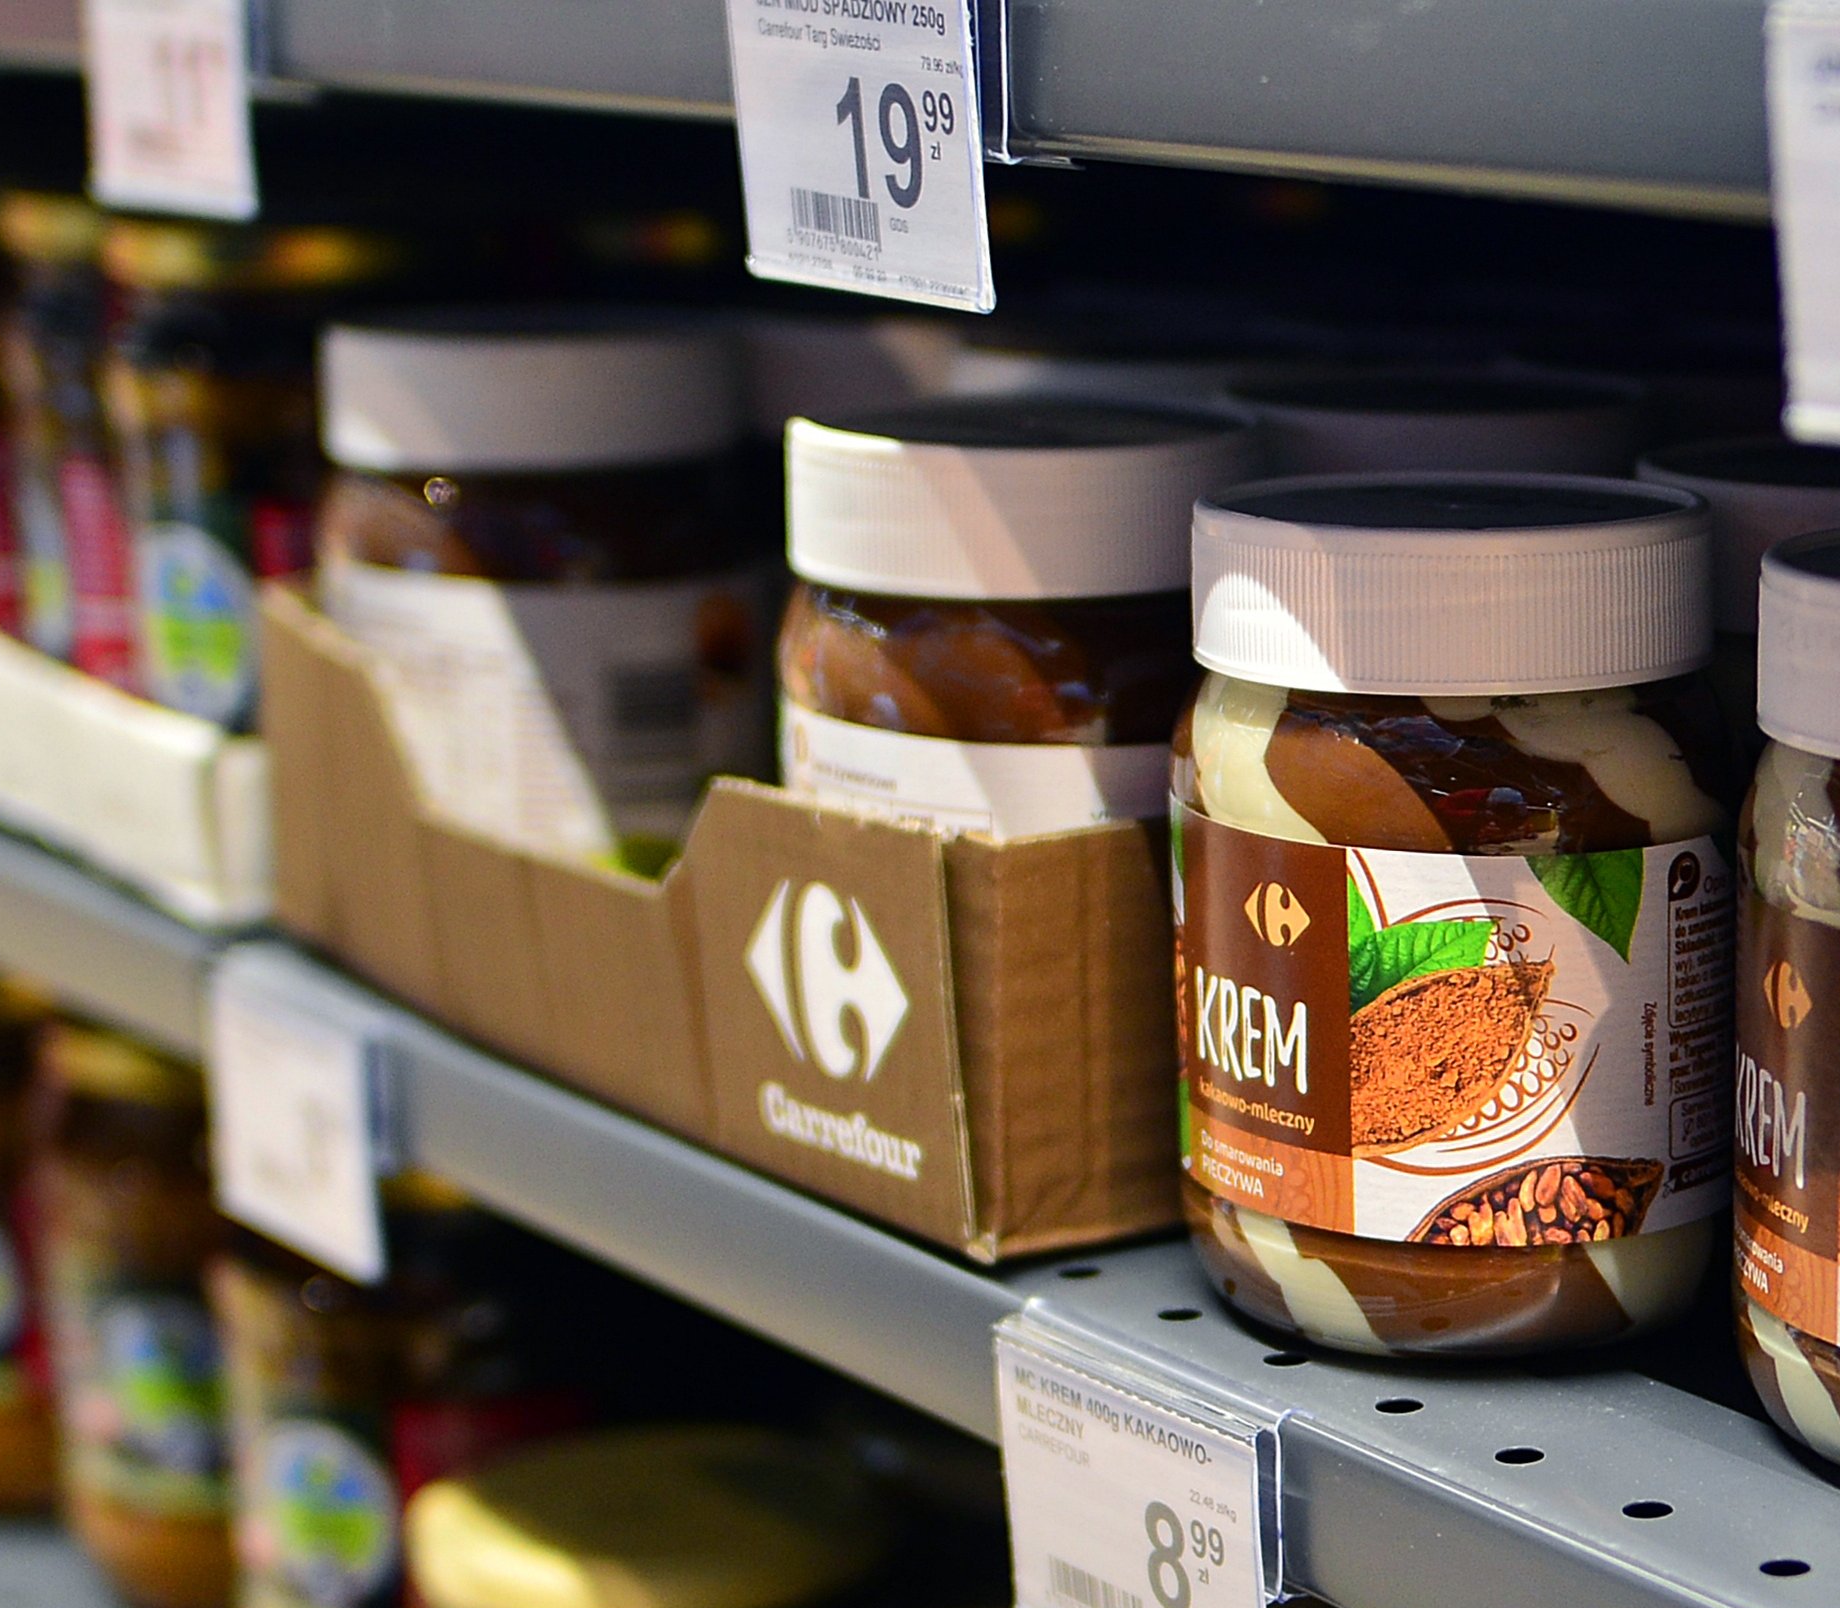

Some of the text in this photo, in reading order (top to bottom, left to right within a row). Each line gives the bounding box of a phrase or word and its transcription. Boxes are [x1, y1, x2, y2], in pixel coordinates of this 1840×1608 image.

[912, 5, 945, 36] 250g
[836, 76, 955, 209] 19 99
[1195, 965, 1308, 1095] KREM
[763, 1081, 922, 1181] Carrefour
[1200, 1076, 1315, 1136] kakaowo-mleczny
[1735, 1042, 1806, 1190] KREM
[1201, 1154, 1265, 1199] PIECZYWA
[1214, 1138, 1285, 1178] smarowania
[1016, 1395, 1085, 1440] MLECZNY
[1040, 1376, 1082, 1411] KREM
[1086, 1398, 1120, 1433] 400g
[1124, 1412, 1213, 1466] KAKAOWO-
[1190, 1519, 1225, 1567] 99
